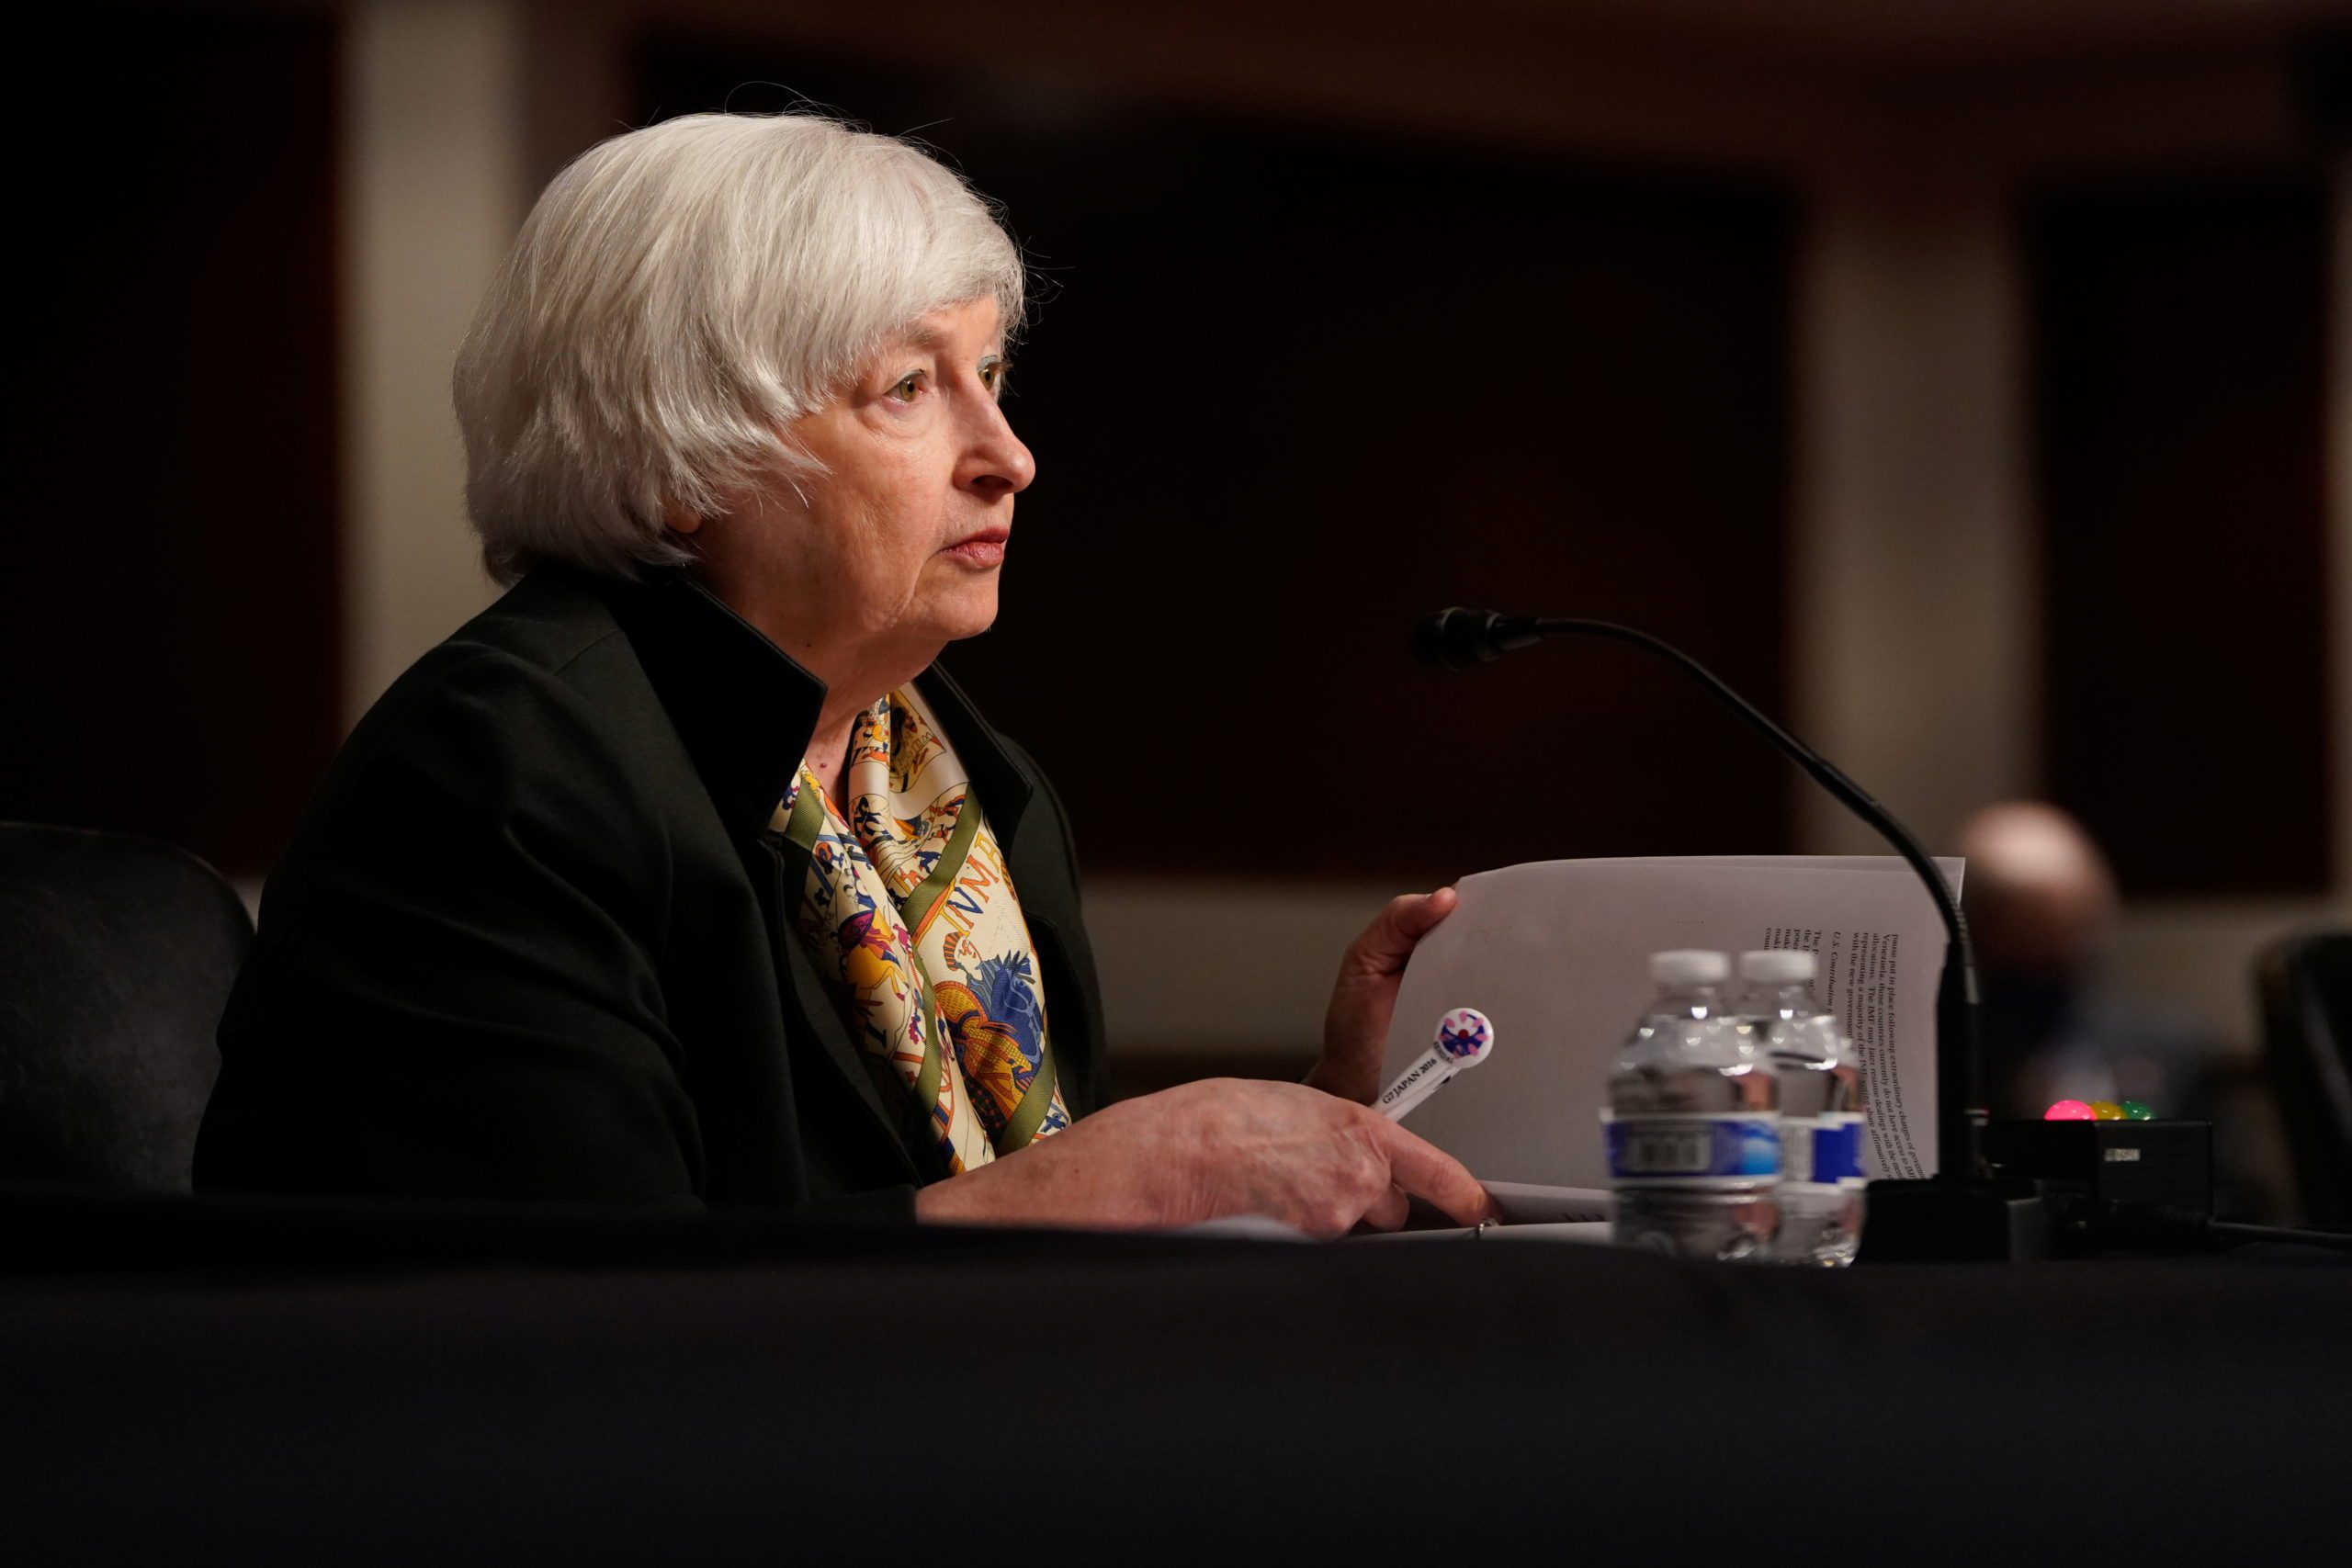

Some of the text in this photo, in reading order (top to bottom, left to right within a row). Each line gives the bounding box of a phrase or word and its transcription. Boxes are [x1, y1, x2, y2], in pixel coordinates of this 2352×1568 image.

[1813, 931, 1822, 946] The
[1832, 931, 1841, 949] U.S.
[1858, 933, 1868, 985] representing
[1869, 933, 1880, 980] allocations.
[1879, 934, 1890, 980] Venezuela,
[1827, 953, 1838, 1005] Contribution
[1890, 976, 1895, 985] in
[1887, 987, 1895, 1010] place
[1856, 995, 1864, 1030] majority
[1858, 1032, 1864, 1041] of
[1880, 1049, 1889, 1086] currently
[1382, 1057, 1437, 1104] G7 JAPAN 2016
[1871, 1069, 1879, 1098] resume
[1890, 1055, 1903, 1110] extraordinary
[1883, 1089, 1891, 1099] do
[1885, 1100, 1894, 1112] not
[1866, 1108, 1875, 1127] share
[1875, 1100, 1886, 1132] dealings
[1889, 1115, 1897, 1132] have
[1898, 1111, 1910, 1140] changes
[1871, 1130, 1891, 1172] affirmatively
[1883, 1134, 1893, 1148] with
[1894, 1134, 1904, 1156] access
[1888, 1151, 1896, 1160] the
[1908, 1152, 1926, 1179] governm
[1893, 1163, 1905, 1179] mem
